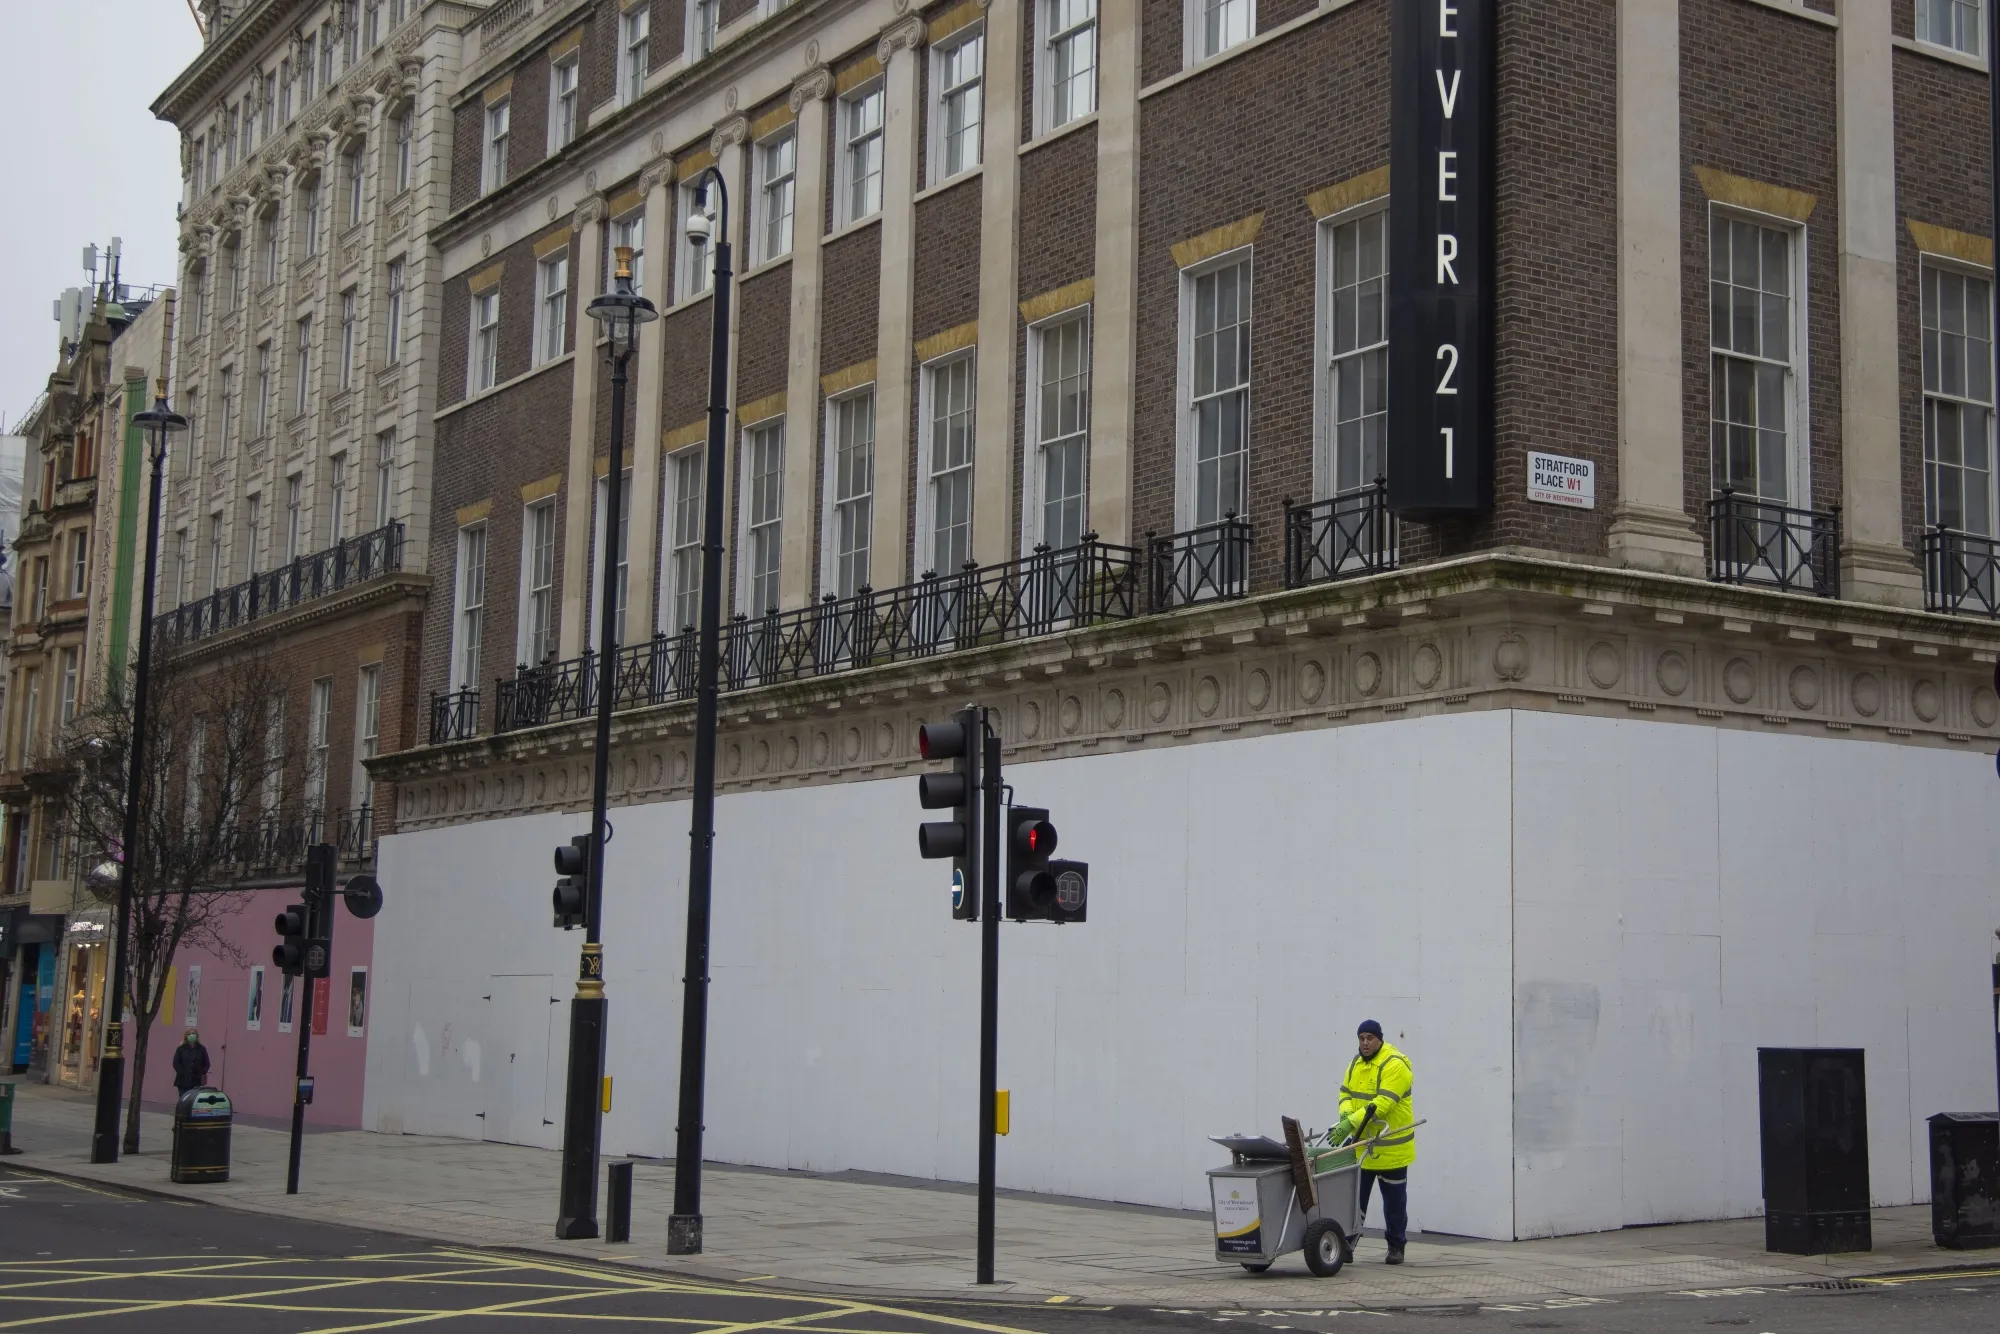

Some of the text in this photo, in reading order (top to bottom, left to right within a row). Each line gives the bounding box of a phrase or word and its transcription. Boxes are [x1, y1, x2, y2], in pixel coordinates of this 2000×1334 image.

[1435, 0, 1461, 479] EVER 21
[1535, 457, 1589, 477] STRATFORD
[1534, 472, 1581, 491] PLACE W1
[1552, 493, 1583, 504] WESTMINSTER
[1478, 1296, 1622, 1312] BOTH
